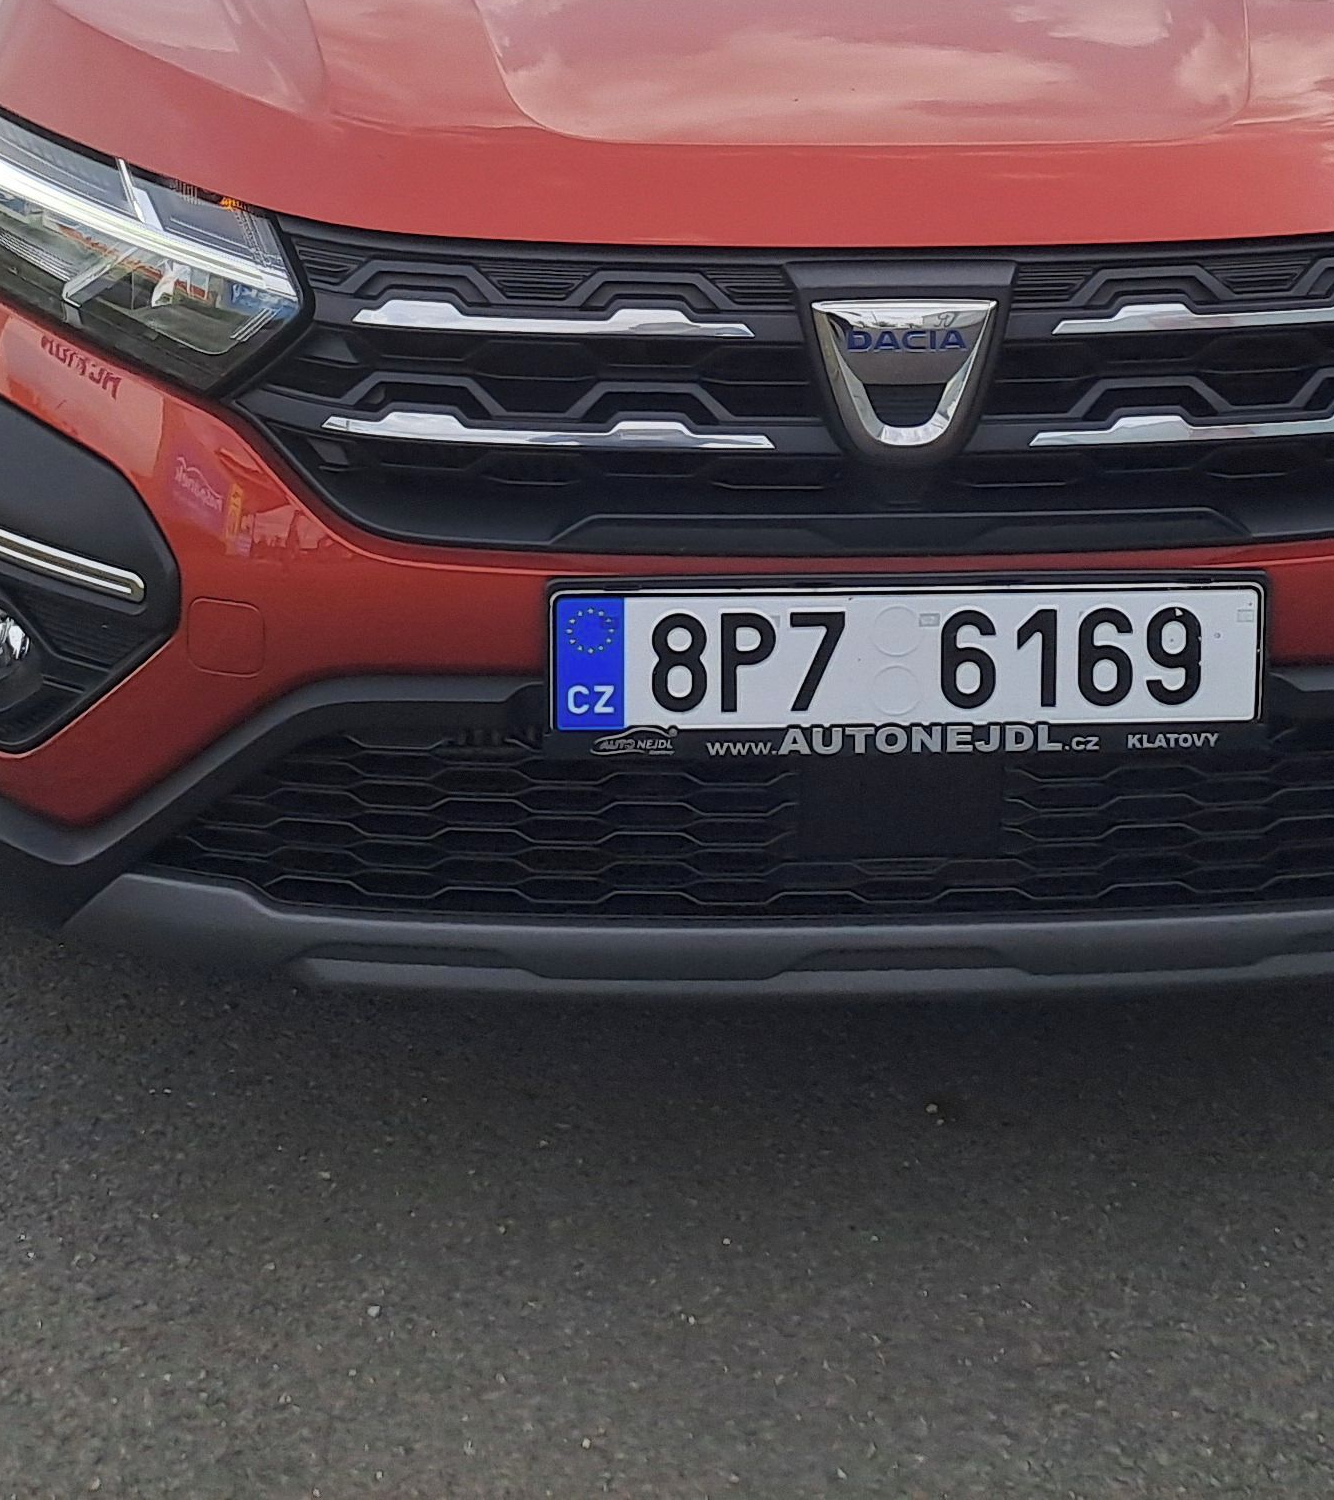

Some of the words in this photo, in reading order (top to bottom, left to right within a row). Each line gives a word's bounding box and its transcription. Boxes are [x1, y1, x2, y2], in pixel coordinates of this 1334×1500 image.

[847, 329, 967, 353] DACIA
[650, 610, 848, 714] 8P7
[938, 606, 1203, 710] 6169
[566, 684, 616, 717] CZ
[599, 738, 635, 750] AUTO
[637, 739, 674, 750] NEJDL
[1127, 732, 1219, 749] KLATOVY
